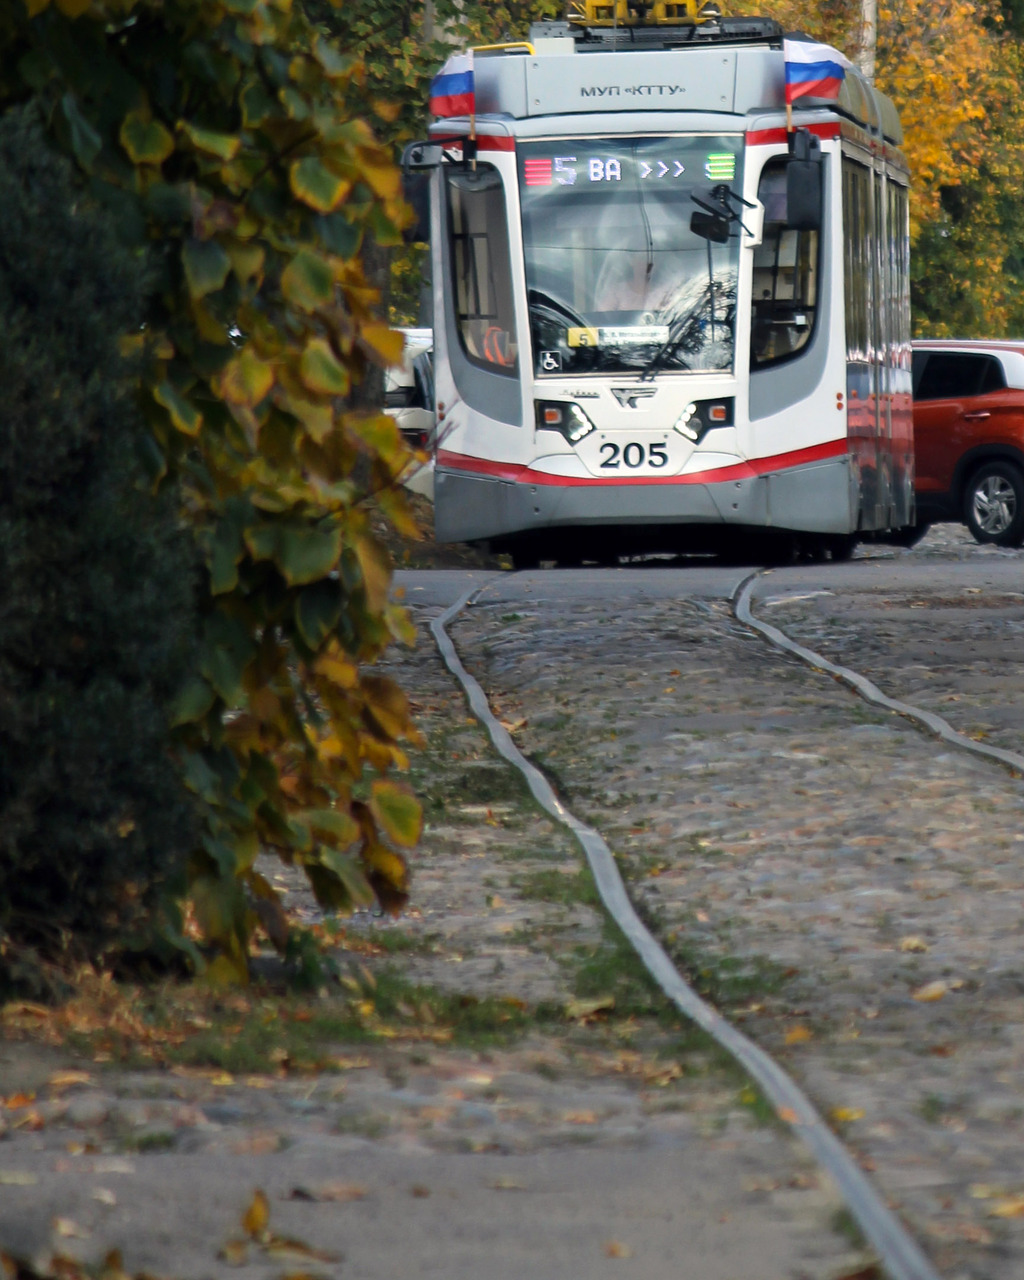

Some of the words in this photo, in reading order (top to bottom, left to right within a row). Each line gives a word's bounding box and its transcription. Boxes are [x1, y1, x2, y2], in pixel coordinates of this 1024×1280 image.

[580, 86, 620, 97] МУП
[624, 85, 687, 96] «КТТУ»
[554, 156, 577, 185] 5
[579, 333, 588, 346] 5
[599, 442, 669, 469] 205
